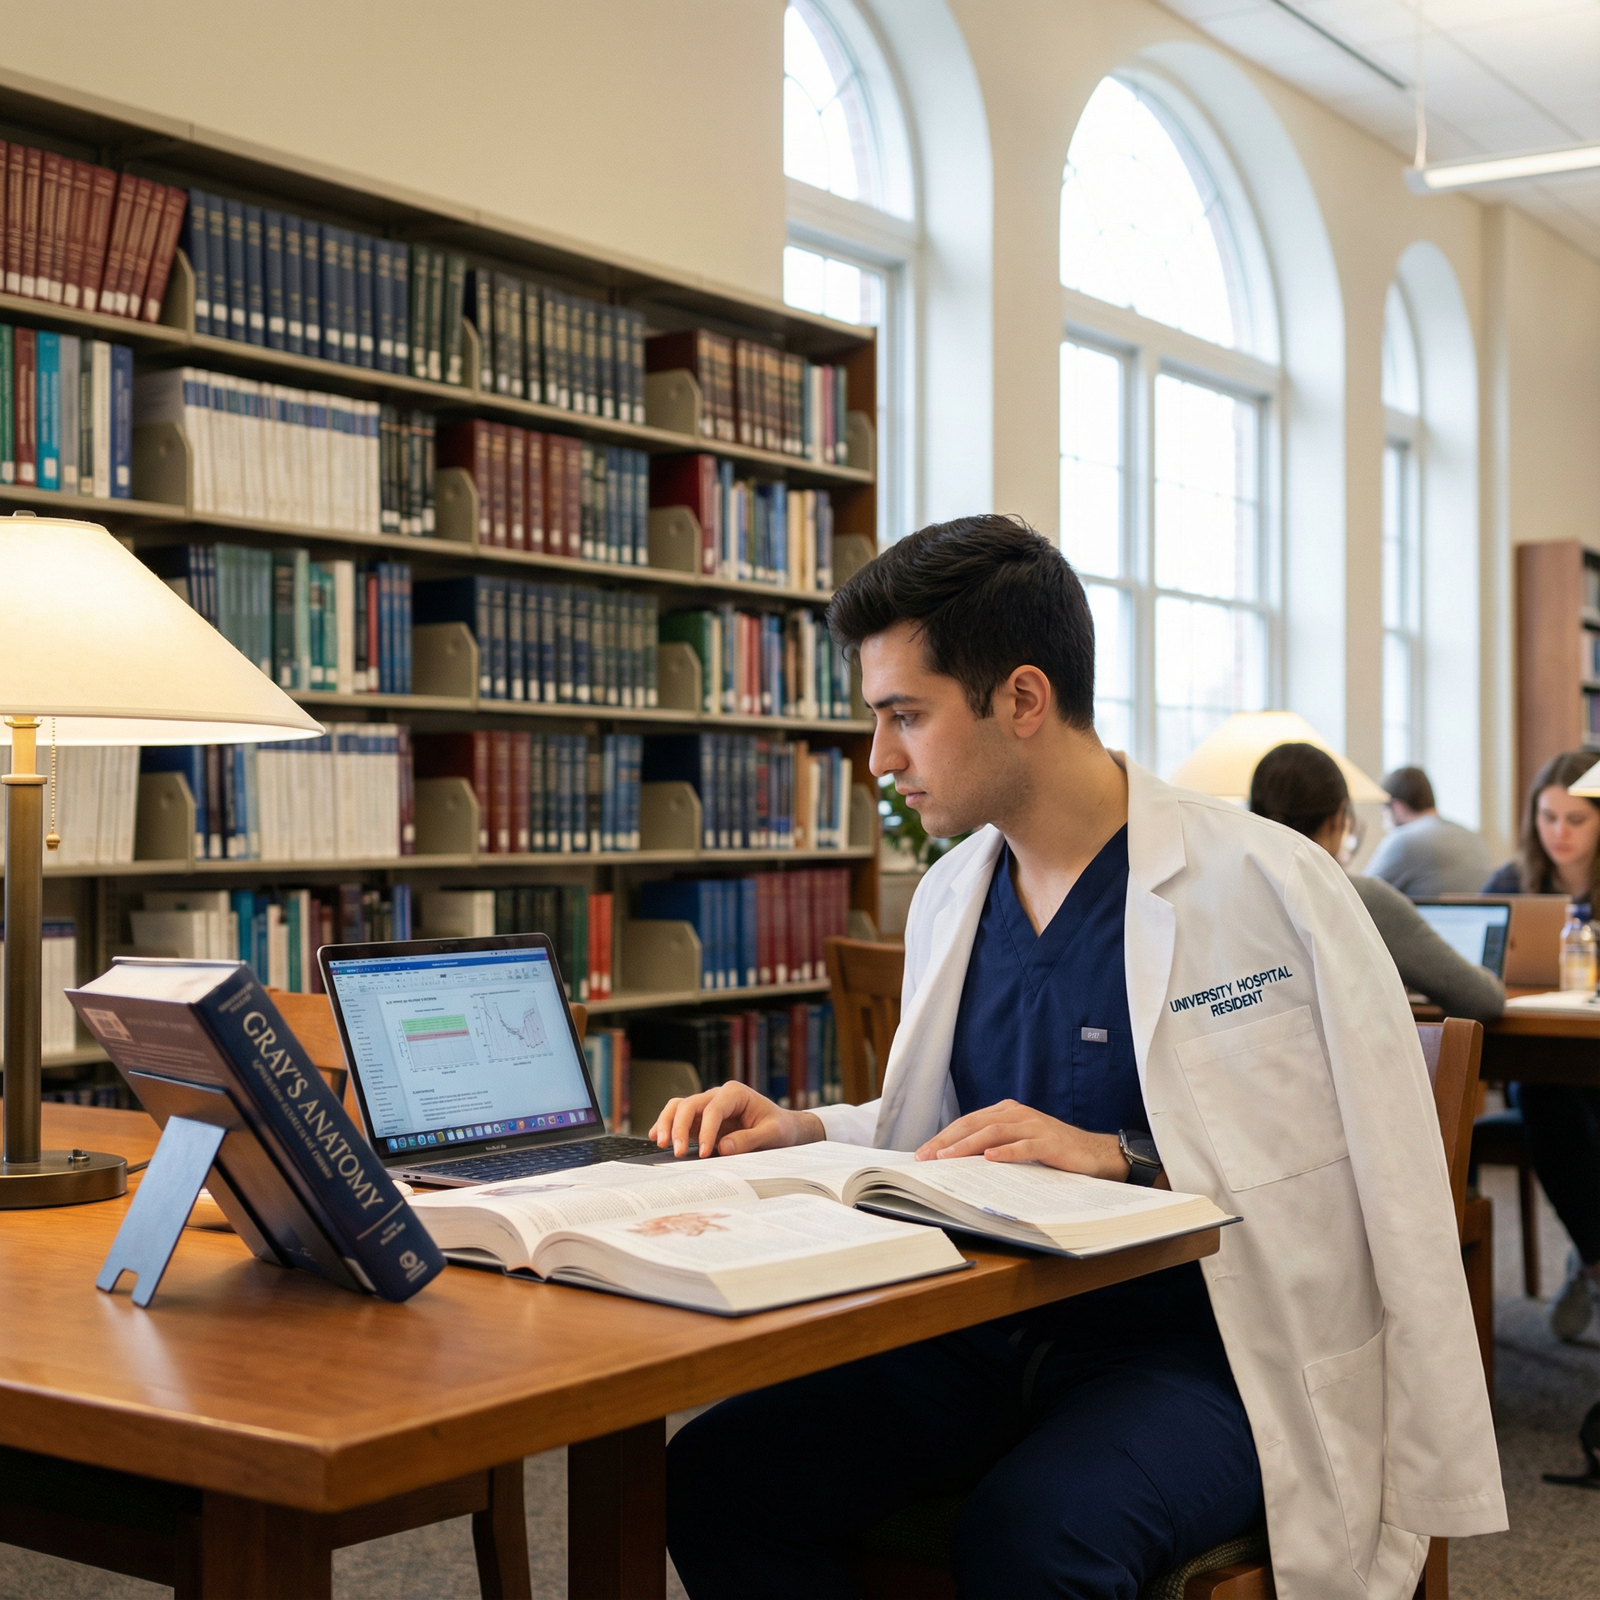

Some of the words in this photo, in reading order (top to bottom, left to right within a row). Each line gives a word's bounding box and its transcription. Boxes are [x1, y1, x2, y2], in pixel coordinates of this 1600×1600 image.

[1169, 982, 1233, 1013] UNIVERSITY
[1236, 965, 1293, 993] HOSPITAL
[1210, 989, 1263, 1018] RESIDENT
[242, 1010, 309, 1100] GRAY'S
[298, 1098, 384, 1211] ANATOMY
